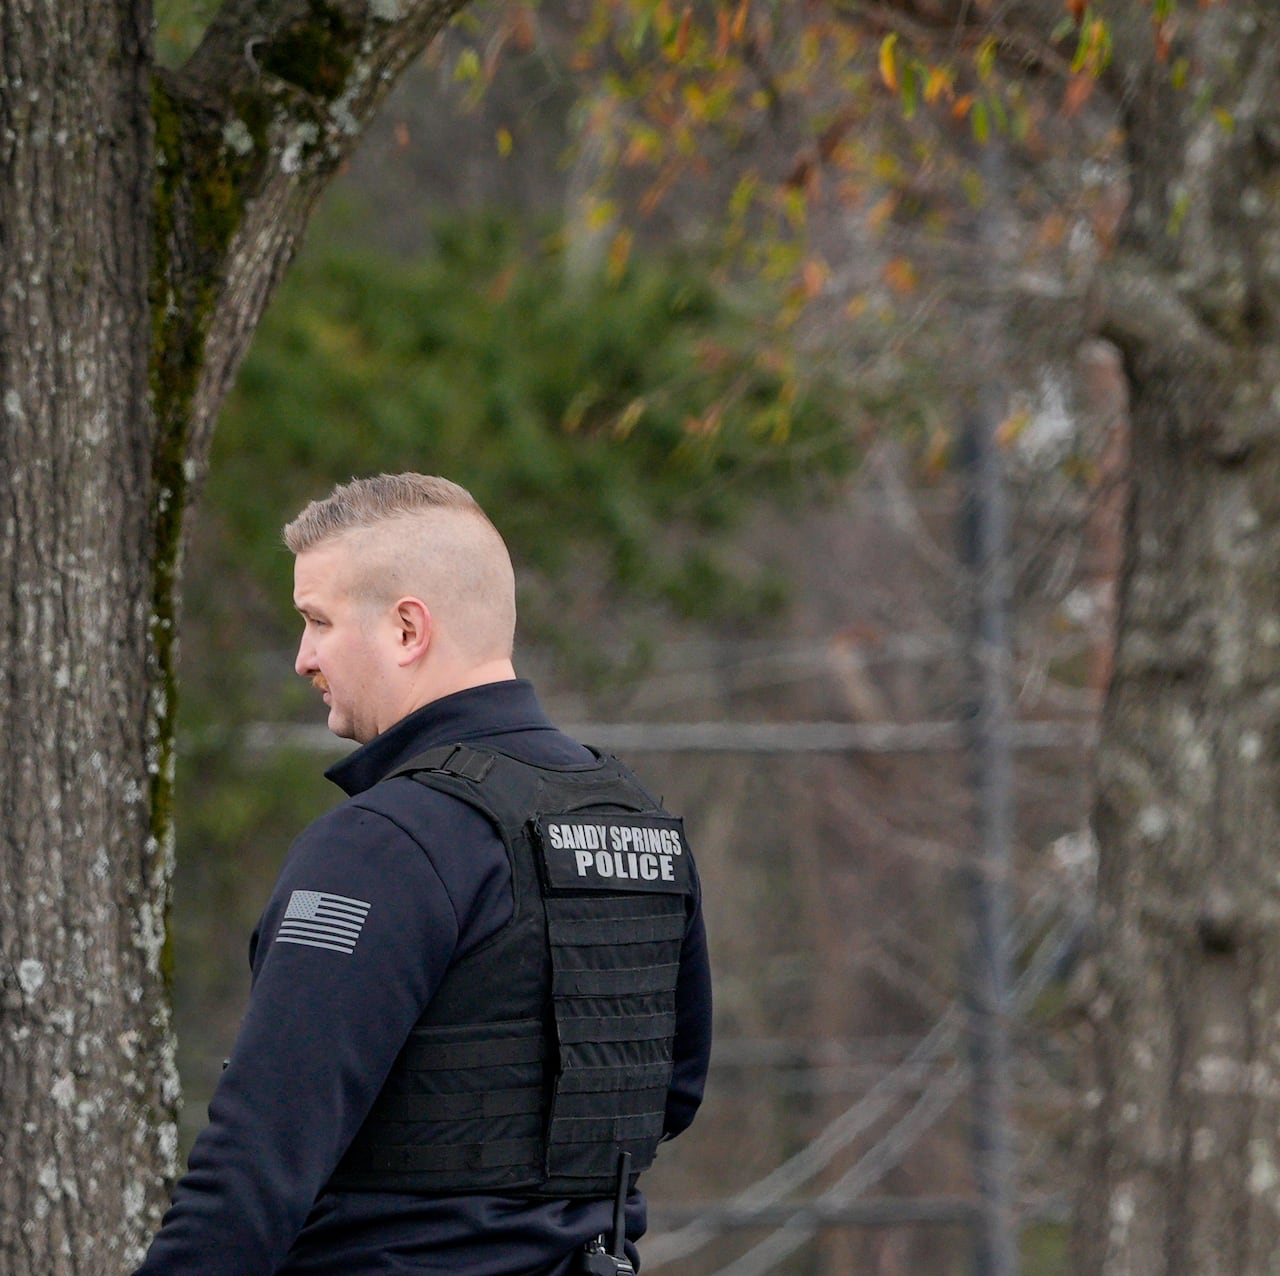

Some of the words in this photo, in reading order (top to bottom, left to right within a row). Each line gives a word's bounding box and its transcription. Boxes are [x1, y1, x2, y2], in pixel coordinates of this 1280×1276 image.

[548, 823, 608, 851] SANDY
[609, 825, 682, 856] SPRINGS
[574, 849, 676, 882] POLICE
